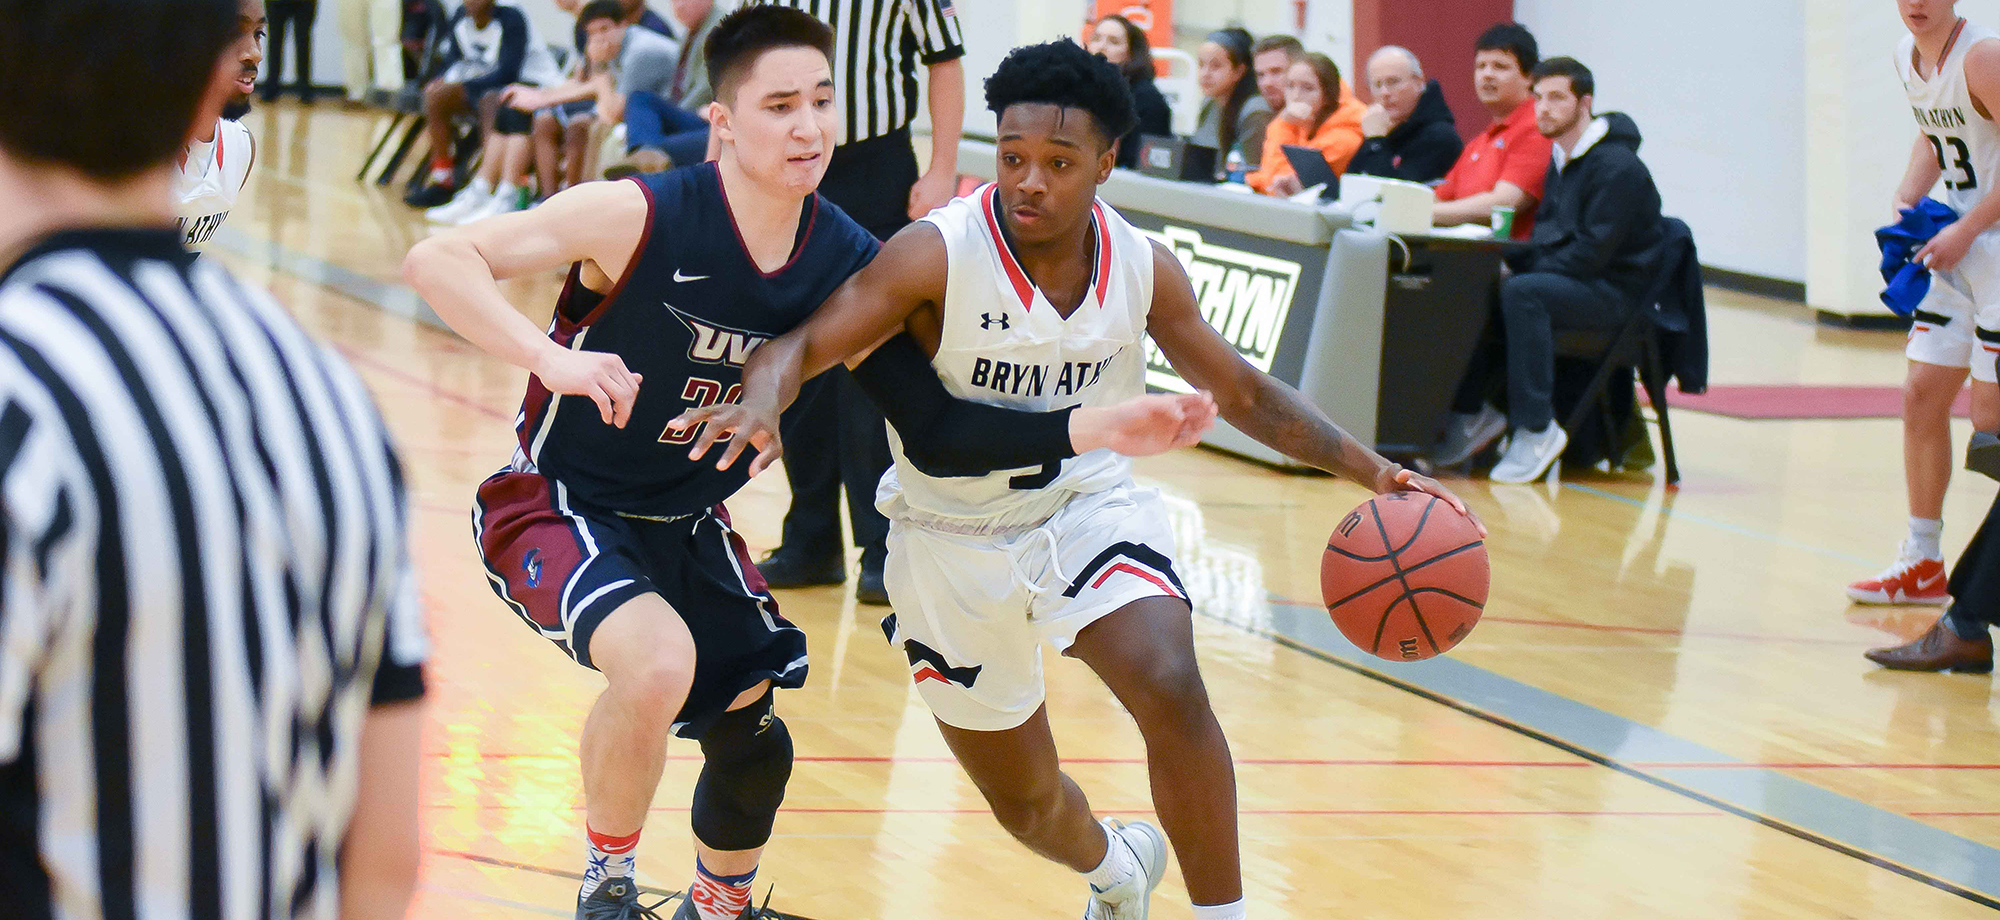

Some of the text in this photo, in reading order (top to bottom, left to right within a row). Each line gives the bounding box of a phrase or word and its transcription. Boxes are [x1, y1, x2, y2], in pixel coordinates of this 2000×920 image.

[183, 209, 230, 245] ATHY
[1176, 246, 1288, 354] THYN
[689, 319, 770, 365] UV
[970, 356, 1049, 397] BRYN
[1053, 346, 1124, 397] ATH
